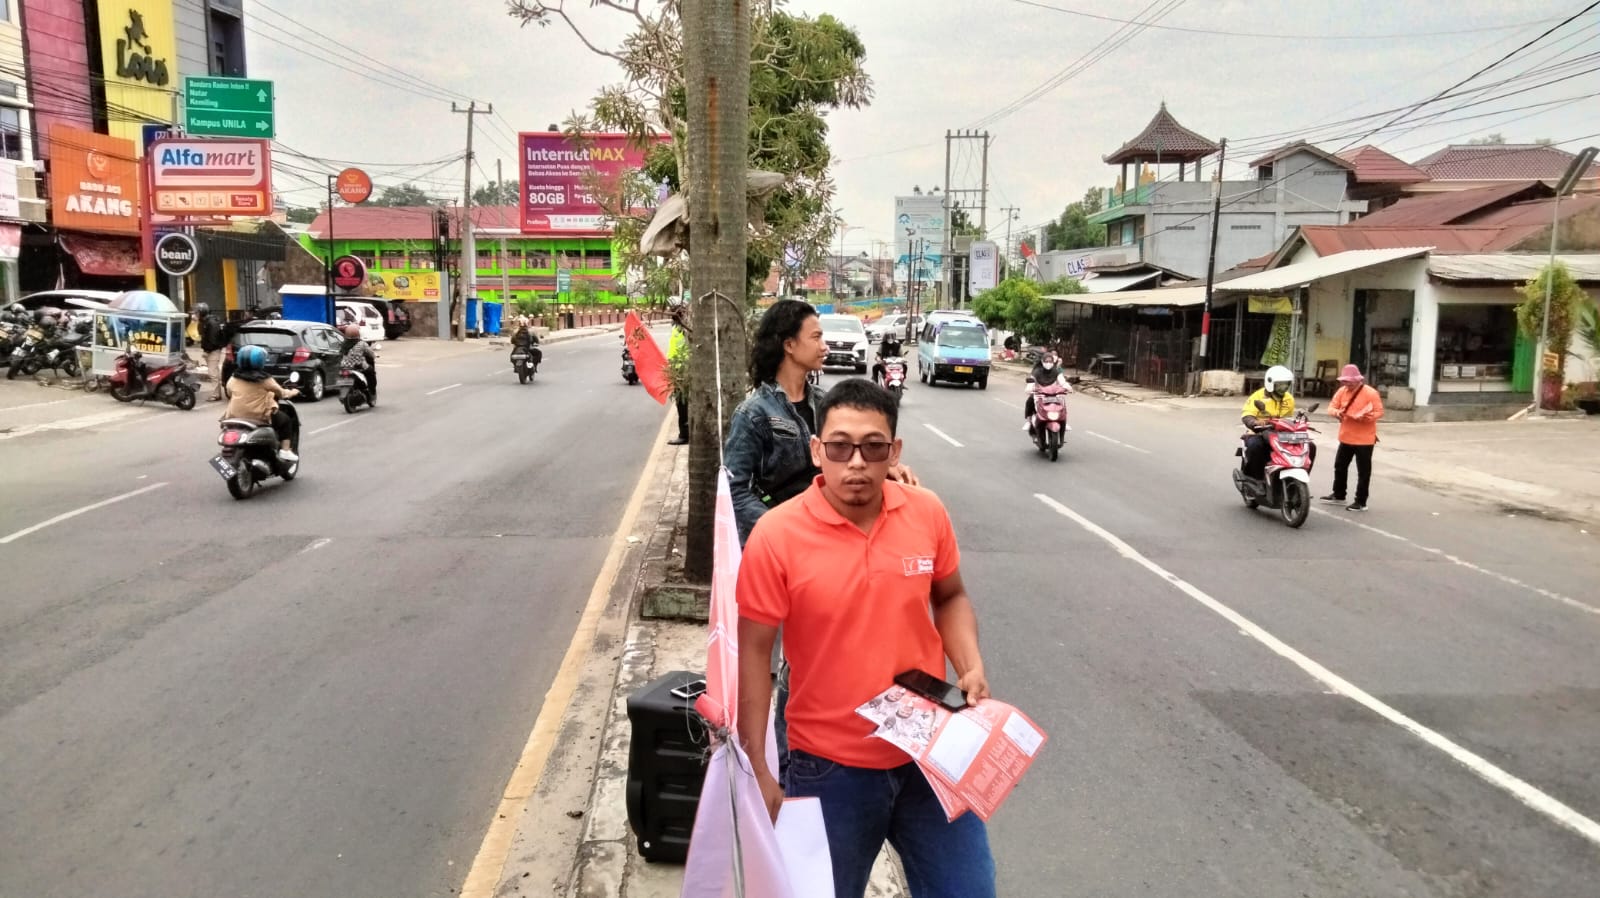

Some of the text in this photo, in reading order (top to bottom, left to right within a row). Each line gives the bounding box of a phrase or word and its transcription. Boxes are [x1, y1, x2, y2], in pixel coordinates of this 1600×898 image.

[116, 39, 169, 86] Lois
[190, 89, 208, 97] Natar
[190, 117, 247, 129] Kampus UNILA
[161, 149, 256, 166] Alfamart
[529, 192, 565, 204] 80GB
[65, 194, 132, 216] AKANG
[161, 247, 192, 260] bean!
